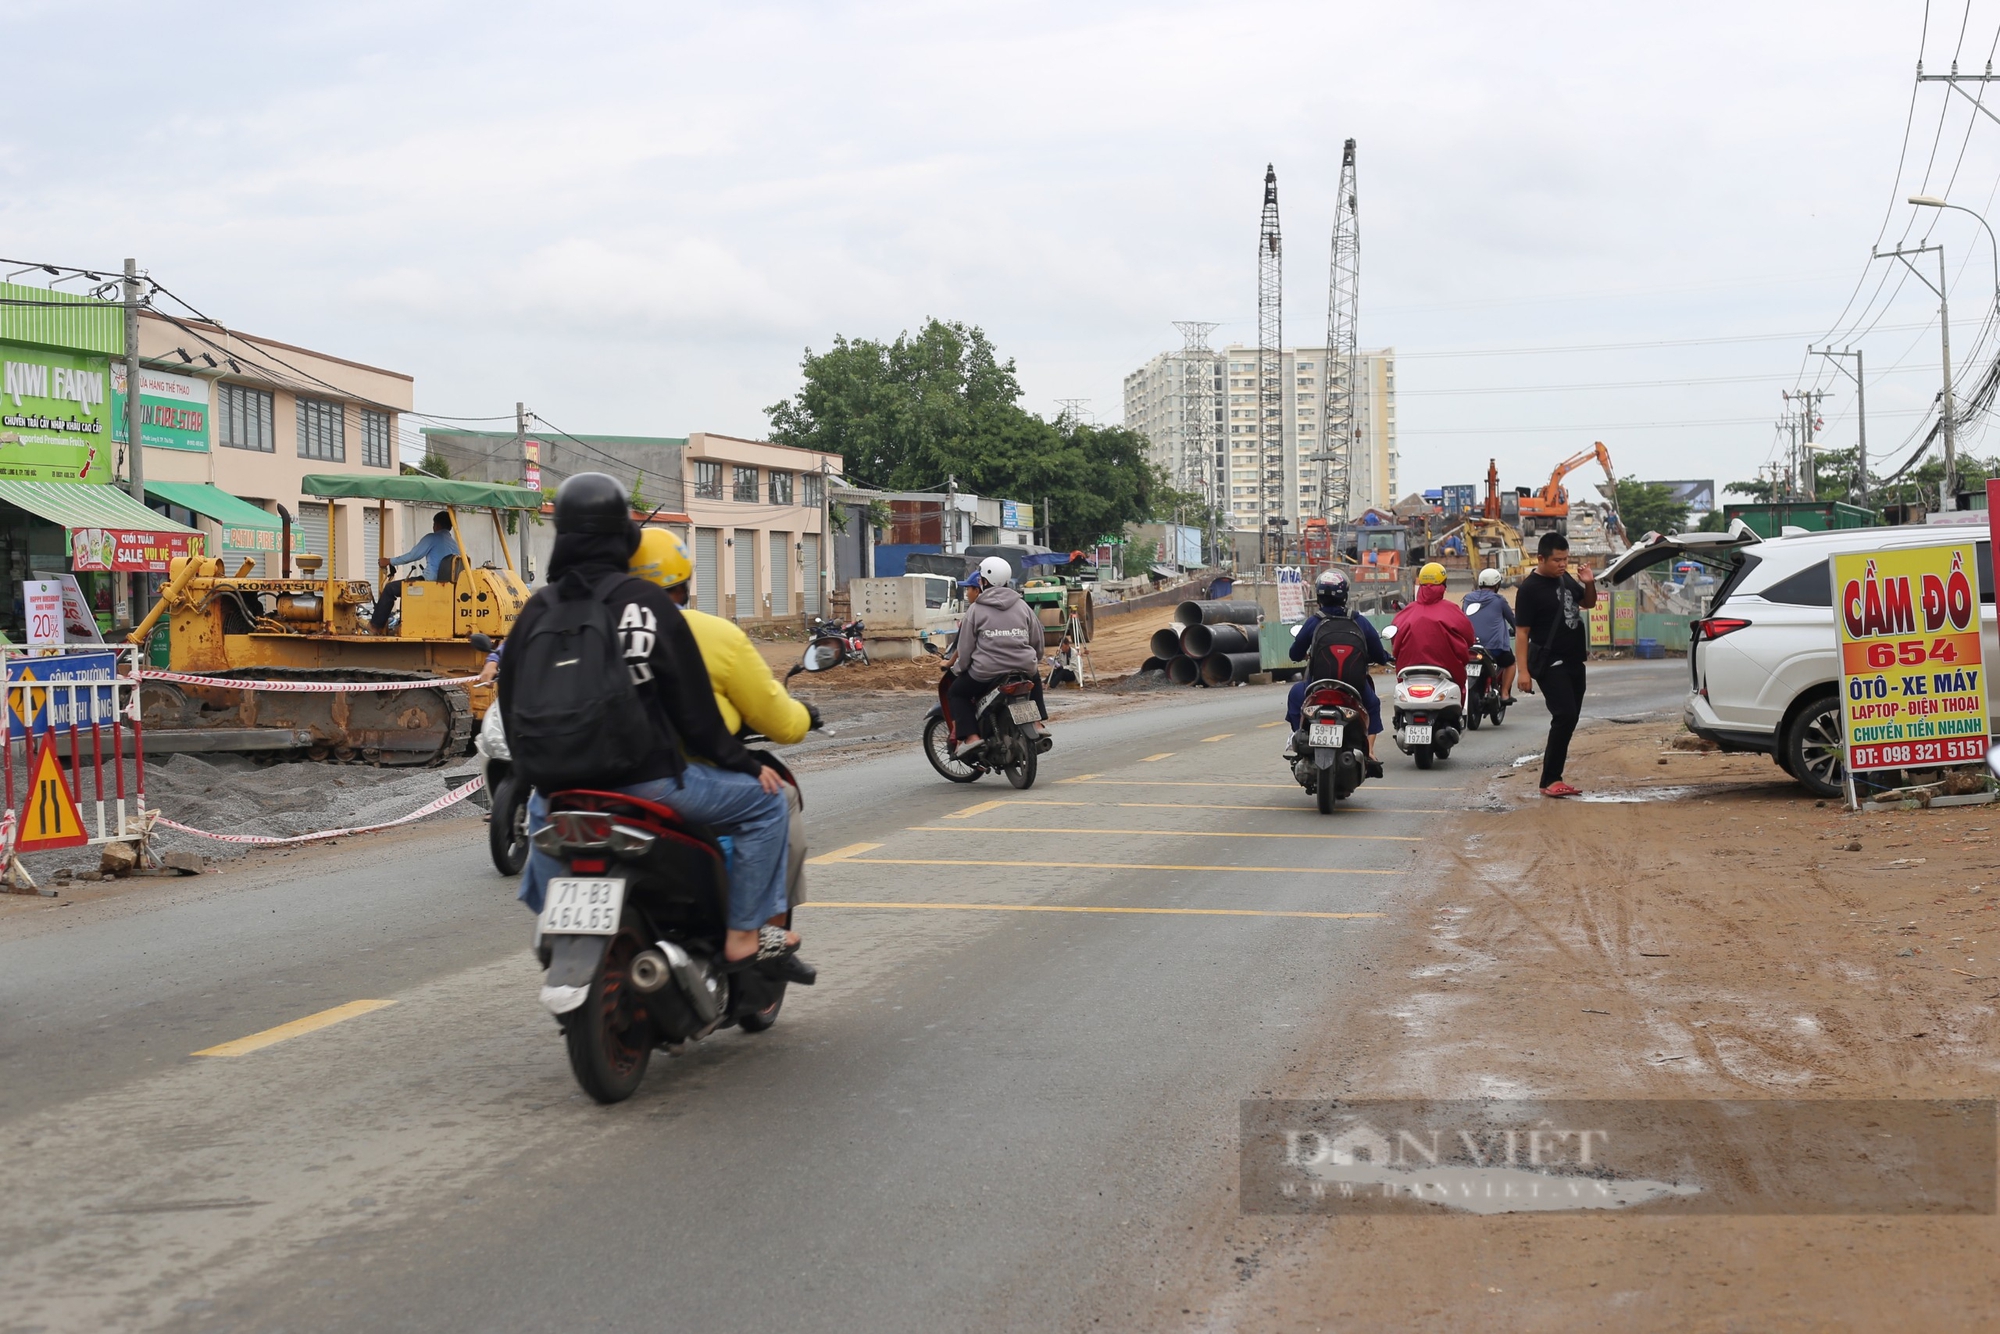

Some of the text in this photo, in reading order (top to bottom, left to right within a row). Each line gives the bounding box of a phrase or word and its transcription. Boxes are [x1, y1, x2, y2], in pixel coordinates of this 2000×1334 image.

[4, 361, 103, 415] KIWI FARM
[177, 383, 190, 395] THAO
[4, 413, 26, 427] CHUYÊN
[27, 414, 39, 428] TRÁI
[40, 415, 50, 428] CÂY
[51, 417, 65, 433] NHẬP
[66, 416, 80, 431] KHẨU
[82, 423, 91, 432] CAO
[44, 434, 69, 446] Premium
[70, 436, 85, 447] Fruits
[121, 532, 136, 544] CUỐI
[230, 528, 254, 549] PATIN
[256, 530, 274, 550] FIRE
[117, 549, 143, 563] SALE
[237, 582, 315, 591] KOMATSU
[1843, 551, 1972, 639] CẦM ĐỒ
[1591, 613, 1608, 621] BÁNH
[1596, 624, 1604, 633] MÌ
[1867, 638, 1958, 669] 654
[1849, 675, 1887, 700] ÔTÔ
[1902, 675, 1927, 696] XE
[1934, 668, 1978, 694] MÁY
[1852, 702, 1899, 720] LAPTOP
[1908, 697, 1938, 718] ĐIỆN
[1941, 696, 1979, 715] THOẠI
[1315, 725, 1338, 736] 59-T1
[1408, 735, 1430, 744] 197.08
[1409, 727, 1428, 735] 64-C1
[1853, 717, 1982, 742] CHUYỂN TIỀN NHANH
[1856, 739, 1984, 766] ĐT: 098 321 5151
[558, 882, 611, 905] 71-B3
[547, 906, 614, 929] 464.65
